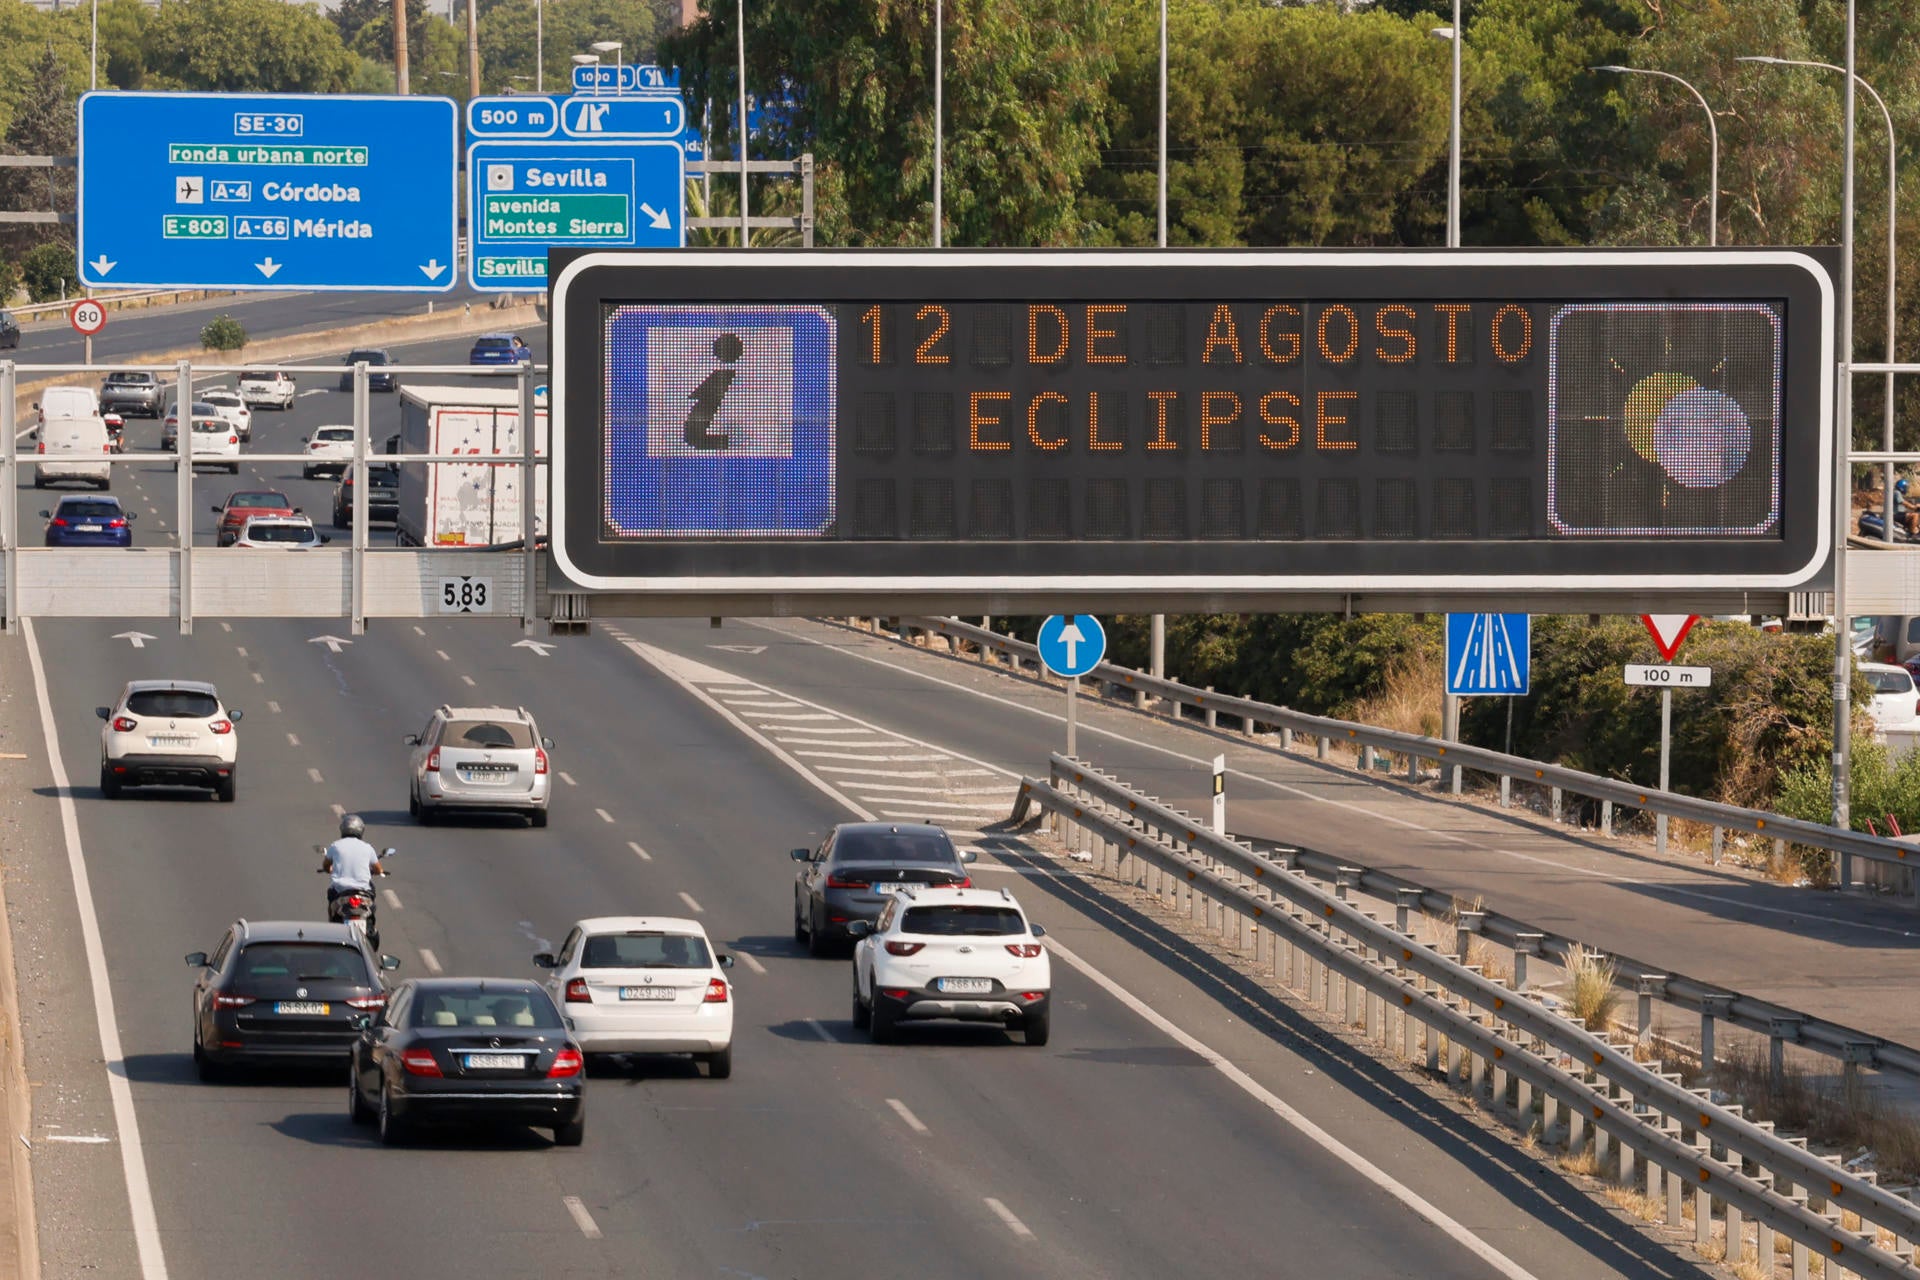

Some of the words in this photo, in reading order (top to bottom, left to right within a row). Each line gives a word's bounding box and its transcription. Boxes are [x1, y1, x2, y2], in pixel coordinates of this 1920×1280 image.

[239, 117, 299, 132] SE-30
[481, 110, 518, 125] 500
[528, 112, 545, 125] m
[663, 110, 672, 124] 1
[171, 147, 229, 162] ronda
[237, 148, 305, 163] urbana
[312, 151, 365, 164] norte
[525, 168, 607, 187] Sevilla
[214, 183, 248, 199] A-4
[262, 181, 361, 202] Córdoba
[489, 199, 561, 214] avenida
[166, 219, 225, 235] E-803
[238, 221, 286, 236] A-66
[293, 217, 373, 239] Mérida
[488, 220, 557, 234] Montes
[569, 219, 624, 234] Sierra
[482, 259, 546, 276] Sevilla
[77, 310, 98, 322] 80
[861, 304, 951, 364] 12
[1028, 304, 1127, 364] DE
[1202, 304, 1533, 364] AGOSTO
[969, 391, 1358, 450] ECLIPSE
[444, 582, 486, 609] 5,83
[1643, 669, 1670, 682] 100
[1680, 672, 1693, 682] m
